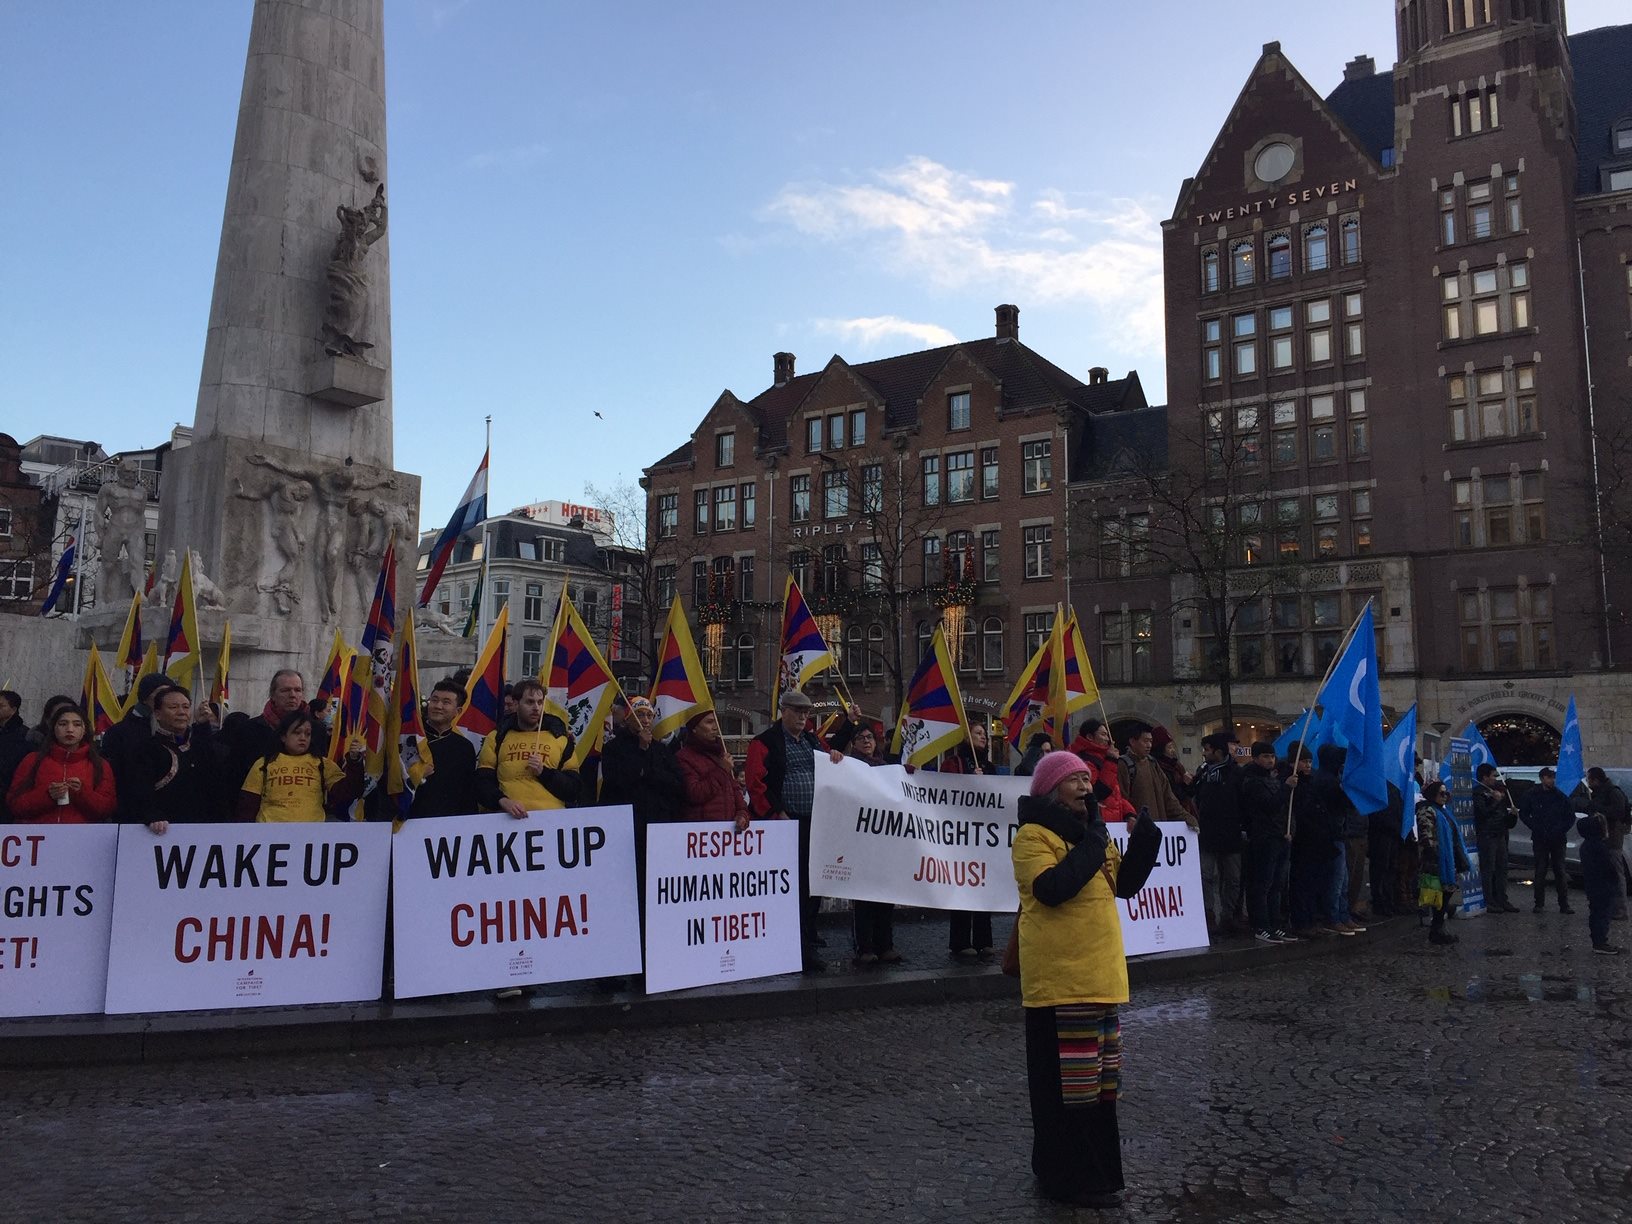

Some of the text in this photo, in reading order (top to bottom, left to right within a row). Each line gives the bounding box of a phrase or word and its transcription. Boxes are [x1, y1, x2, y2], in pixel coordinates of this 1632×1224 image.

[1197, 179, 1357, 226] TWENTY SEVEN
[561, 503, 601, 523] HOTEL
[793, 519, 873, 538] RIPLEY'S
[507, 751, 550, 763] TIBT
[508, 742, 551, 753] we are
[268, 775, 316, 787] TIBET
[269, 766, 314, 776] we are
[901, 781, 1006, 809] INTERNATIONAL
[855, 806, 926, 841] HUMAN
[925, 818, 1000, 848] RIGHTS
[424, 826, 606, 880] WAKE UP
[687, 829, 765, 859] RESPECT
[1165, 836, 1187, 867] UP
[154, 843, 358, 890] WAKE UP
[913, 856, 986, 887] JOIN US!
[657, 868, 790, 905] HUMAN RIGHTS
[1127, 885, 1184, 921] CHINA!
[450, 893, 589, 947] CHINA!
[687, 911, 766, 947] IN TIBET!
[174, 913, 330, 963] CHINA!
